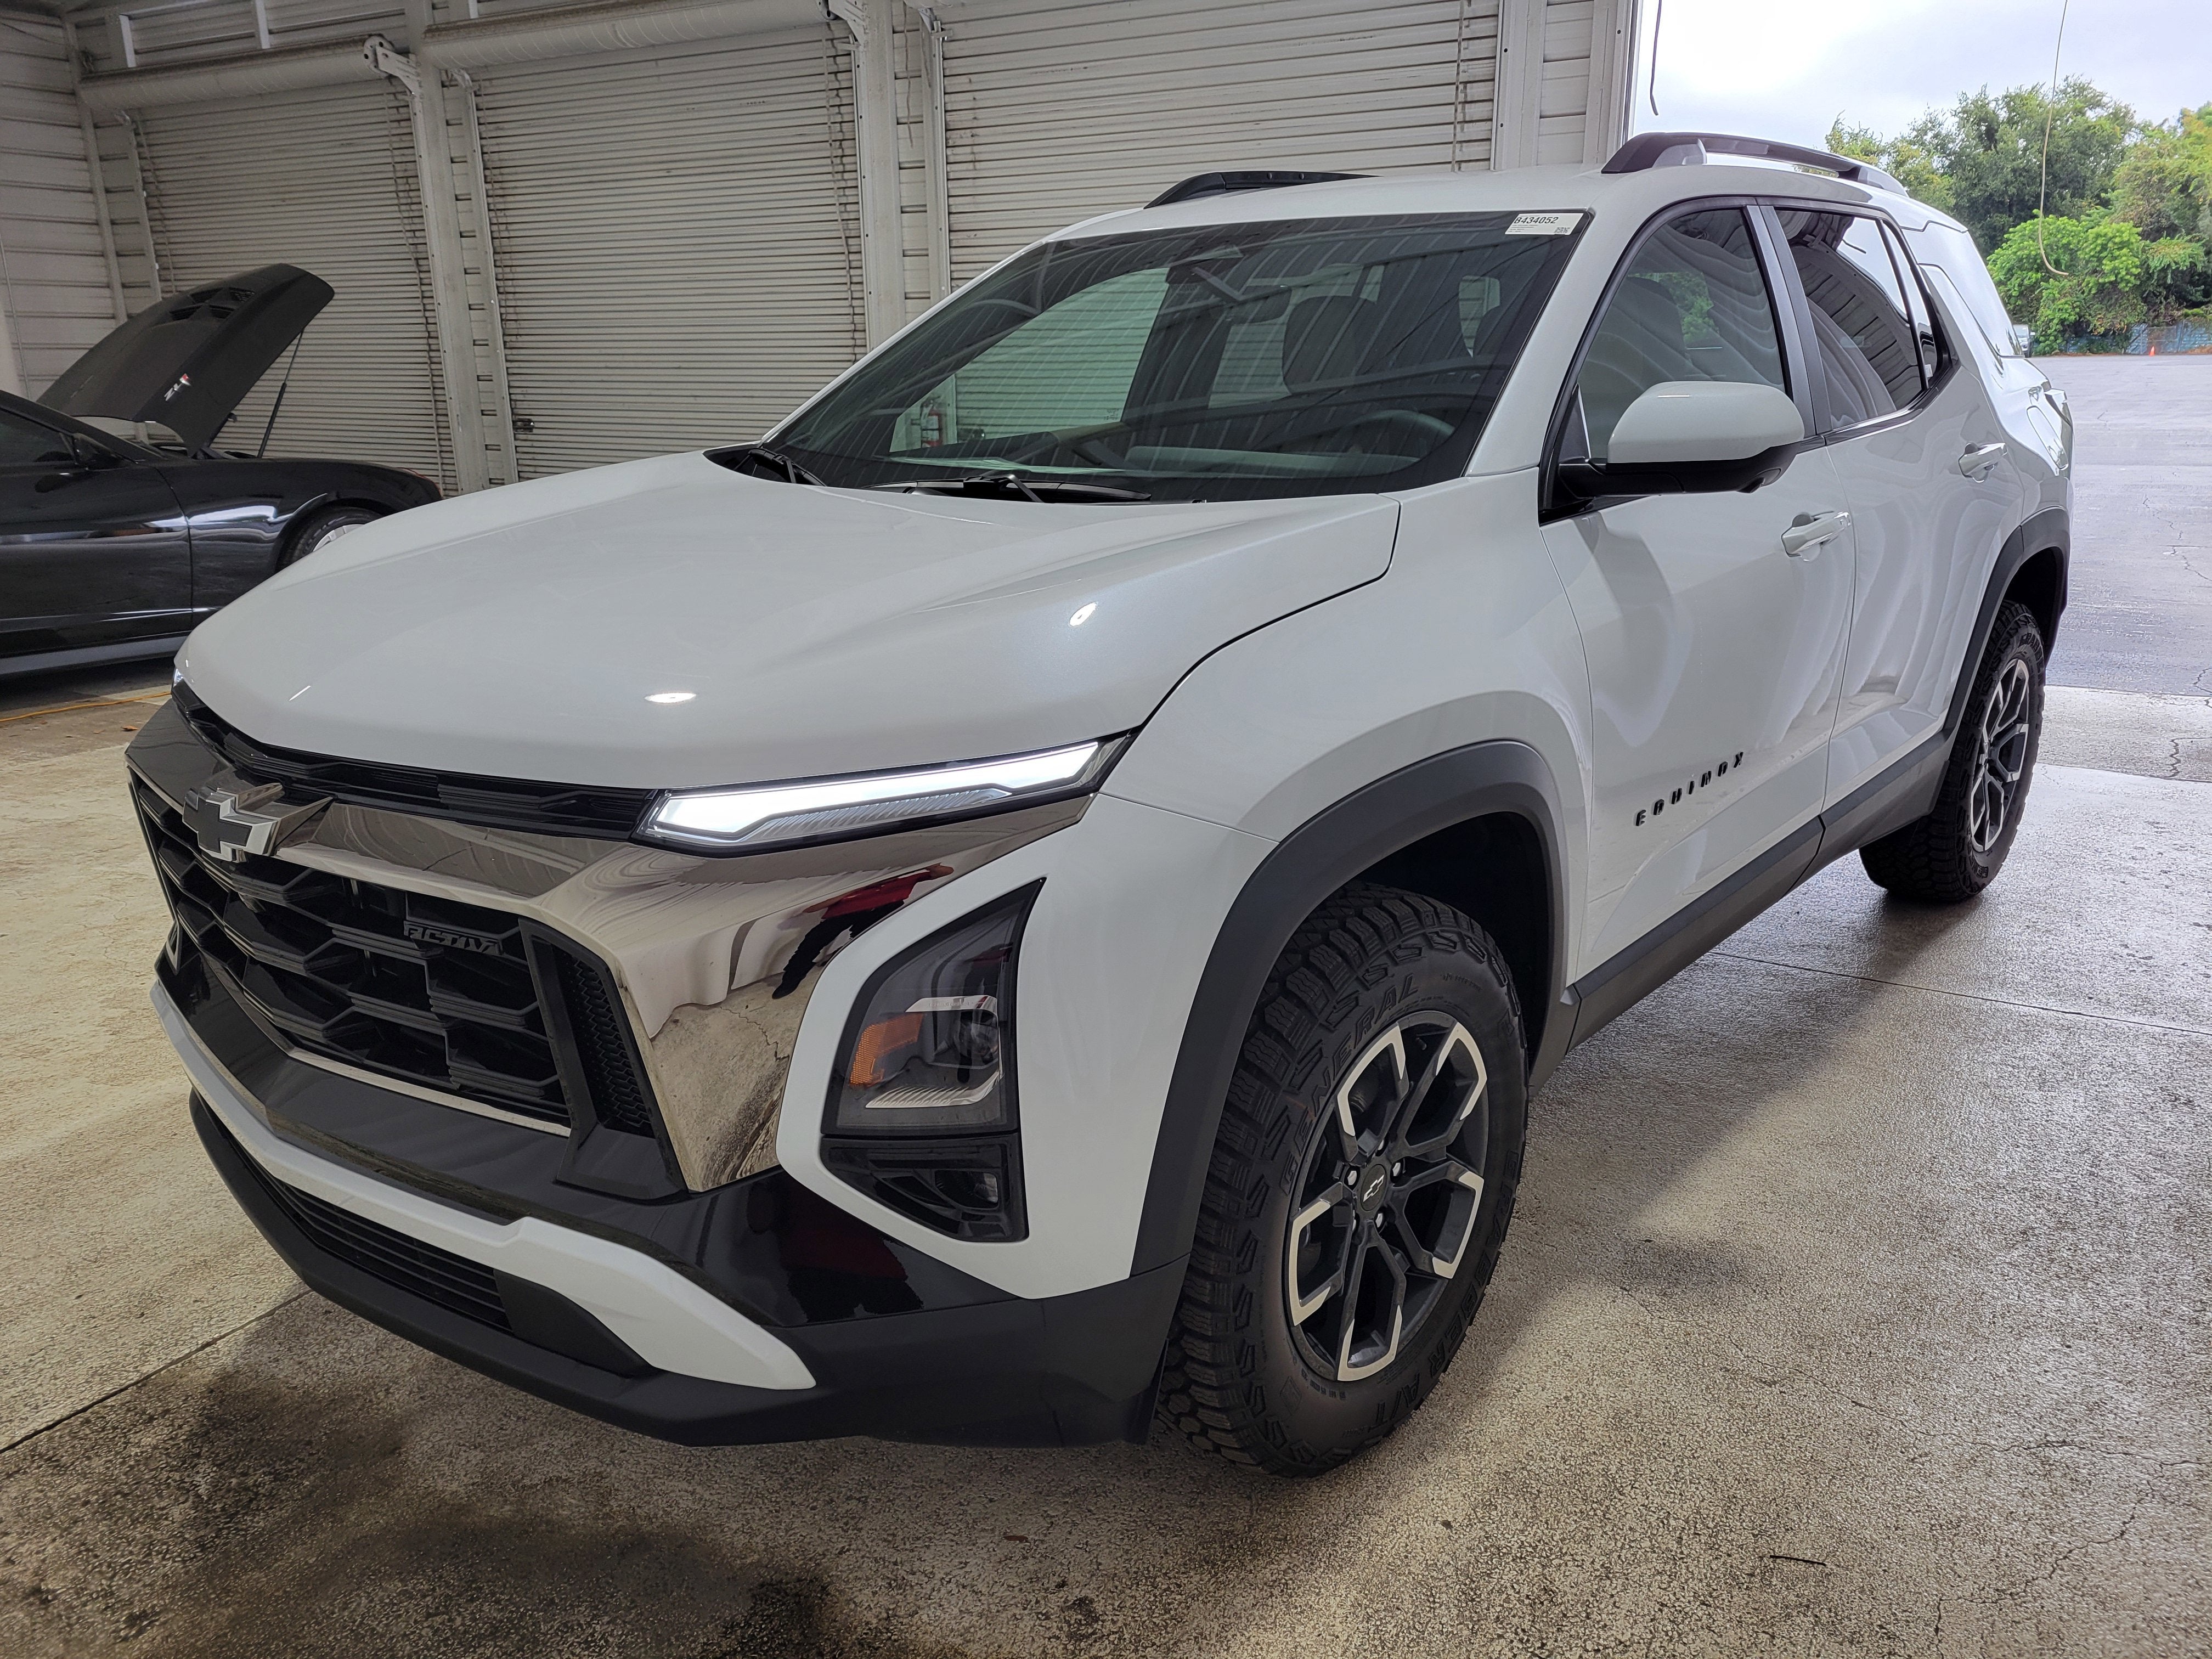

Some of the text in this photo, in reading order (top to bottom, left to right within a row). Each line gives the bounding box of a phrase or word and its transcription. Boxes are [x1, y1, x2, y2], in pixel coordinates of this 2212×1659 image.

[1634, 751, 1744, 827] EQUINOX
[1280, 973, 1418, 1197] GENERAL
[1428, 1151, 1520, 1379] GRABBER
